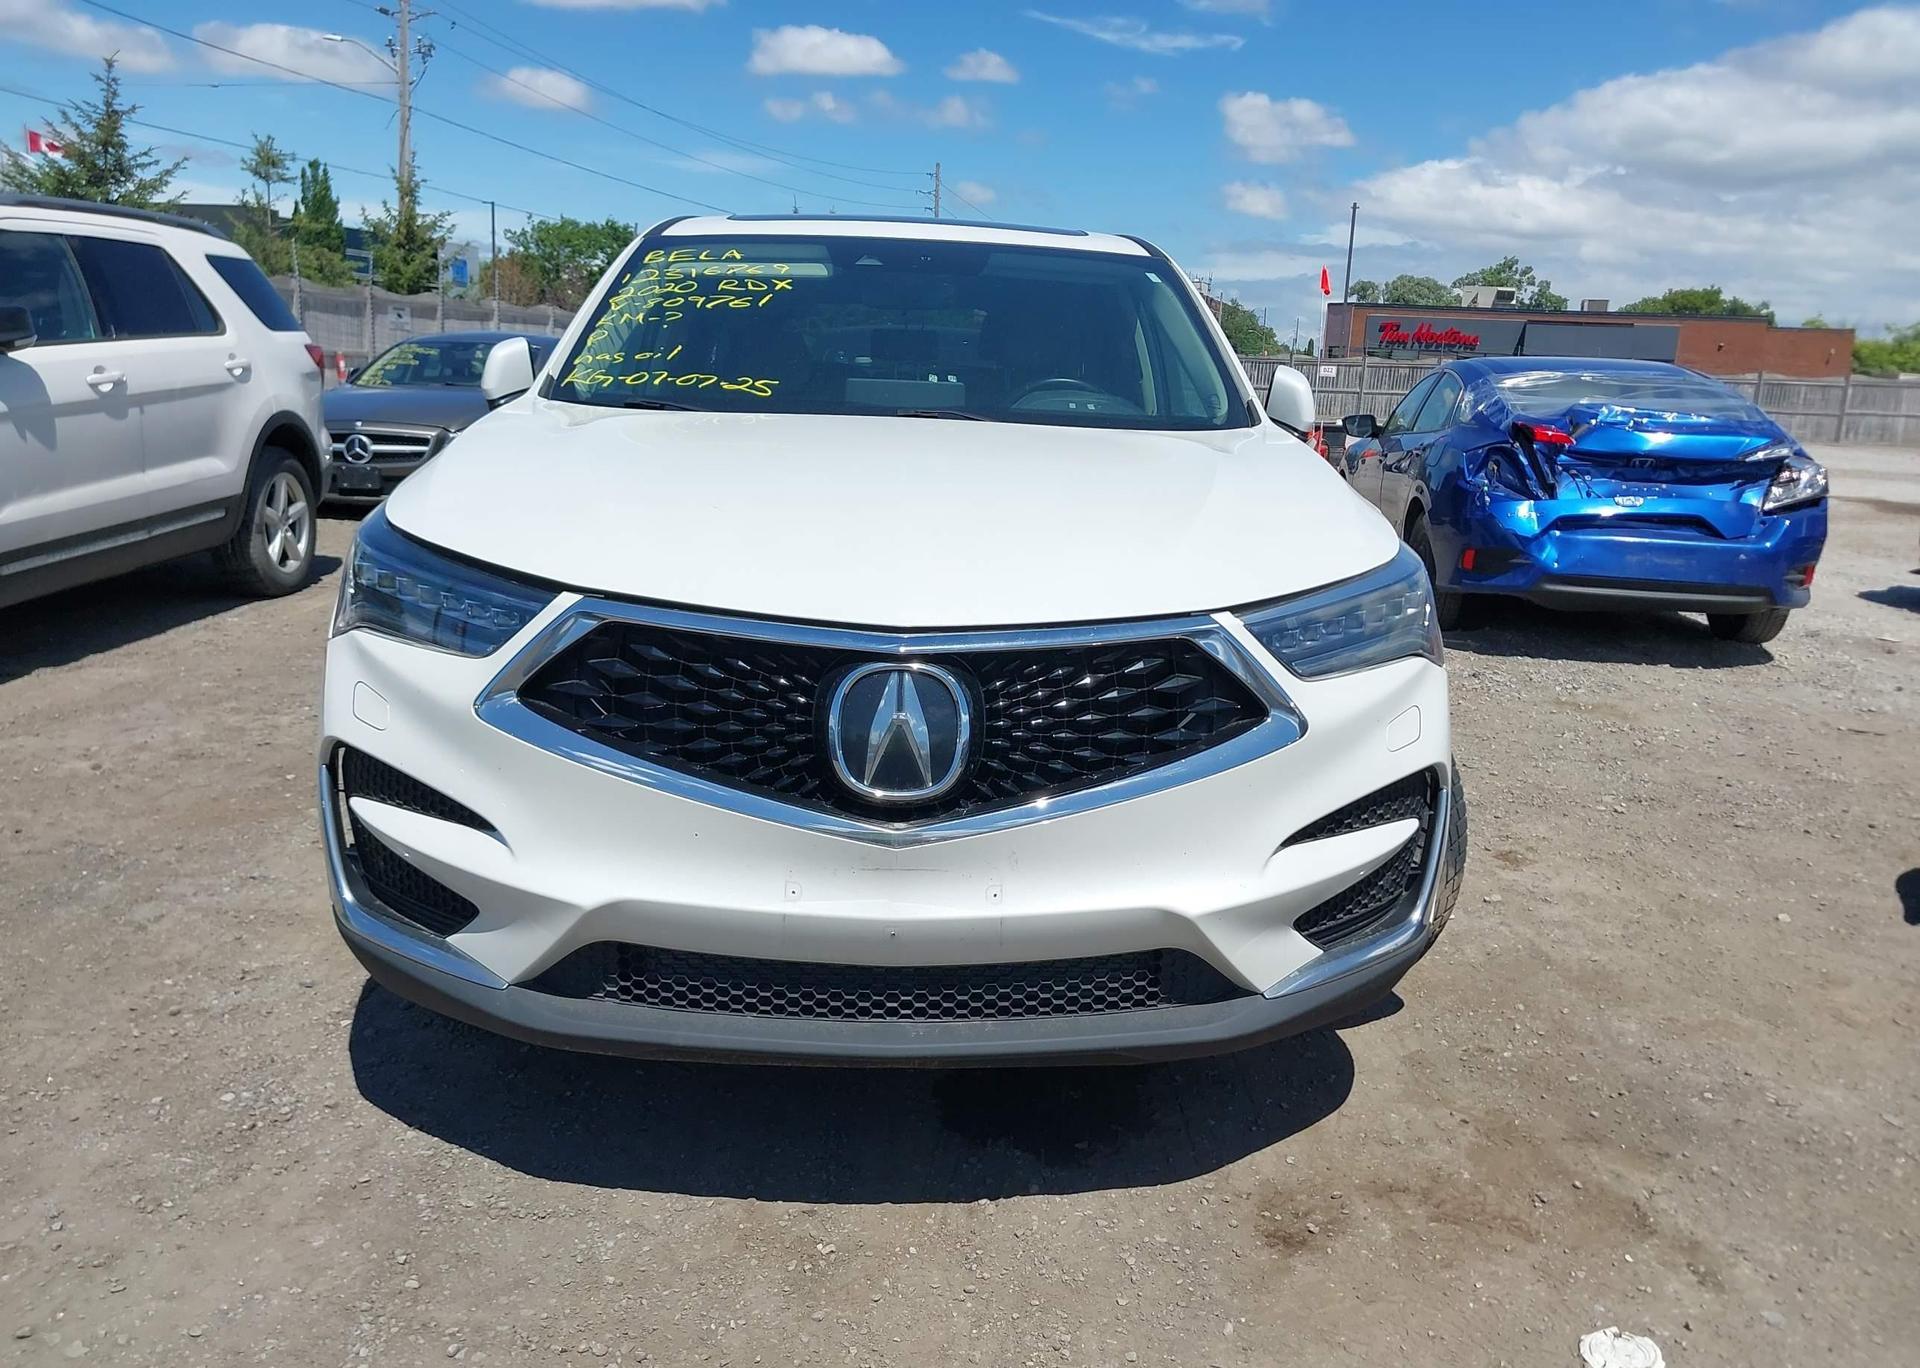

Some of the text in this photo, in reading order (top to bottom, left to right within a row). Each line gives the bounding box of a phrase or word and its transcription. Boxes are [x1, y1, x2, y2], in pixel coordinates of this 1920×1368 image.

[643, 249, 745, 263] BELA
[610, 279, 793, 302] 2020 RDX
[1378, 320, 1480, 347] Tim Hortons
